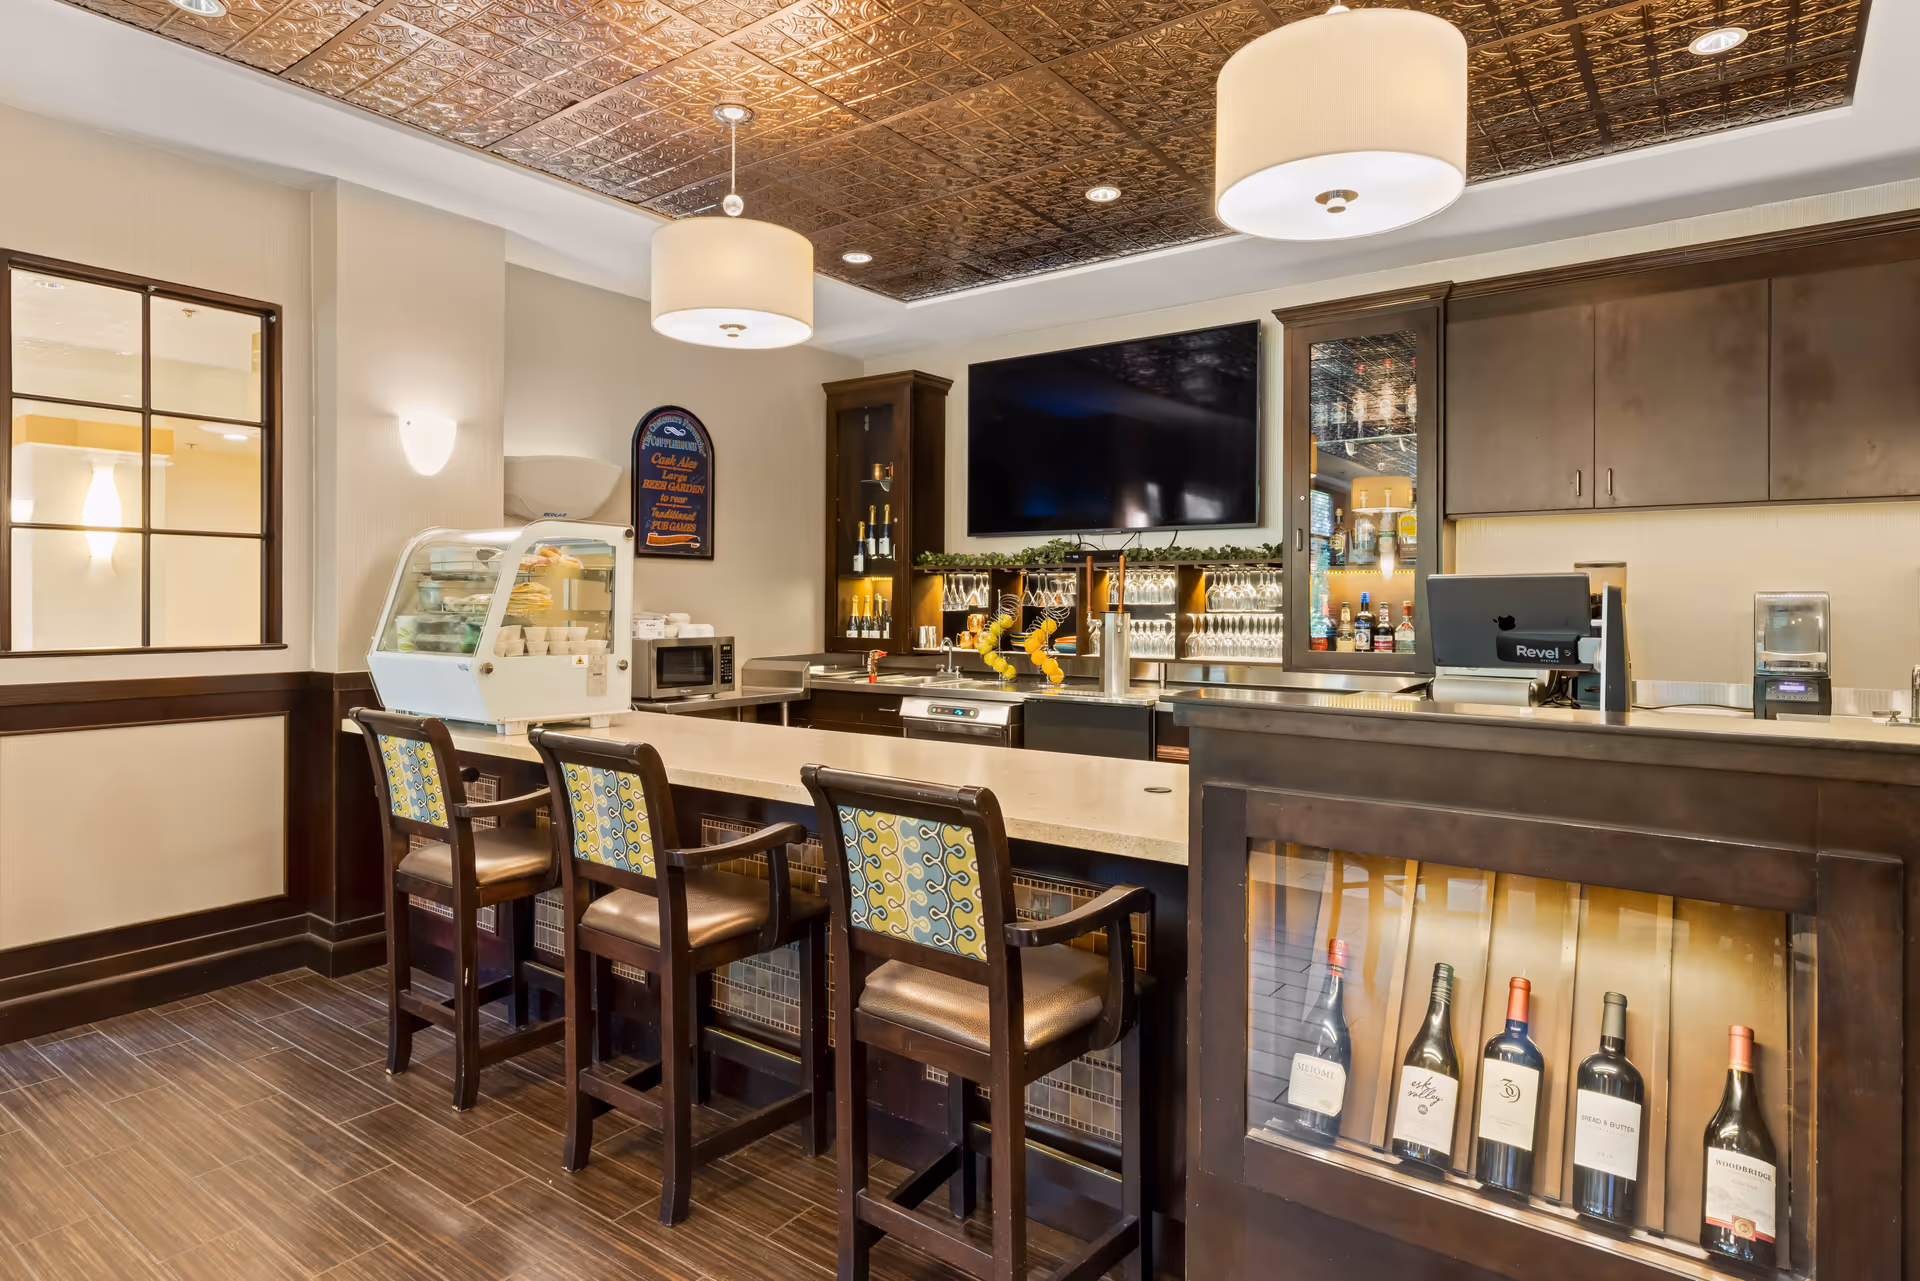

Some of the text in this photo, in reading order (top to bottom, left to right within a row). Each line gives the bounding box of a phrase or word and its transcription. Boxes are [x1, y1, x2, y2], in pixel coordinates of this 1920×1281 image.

[651, 452, 698, 469] Cask Ales
[661, 469, 688, 483] Large
[641, 478, 705, 495] BEER GARDEN
[660, 493, 688, 504] to rear
[651, 506, 697, 521] Traditional
[651, 520, 697, 533] PUB GAMES
[1516, 644, 1559, 659] Revel
[1581, 1114, 1602, 1125] BREAD
[1609, 1121, 1635, 1133] BUTTER
[1715, 1159, 1772, 1182] WOODBRIDGE
